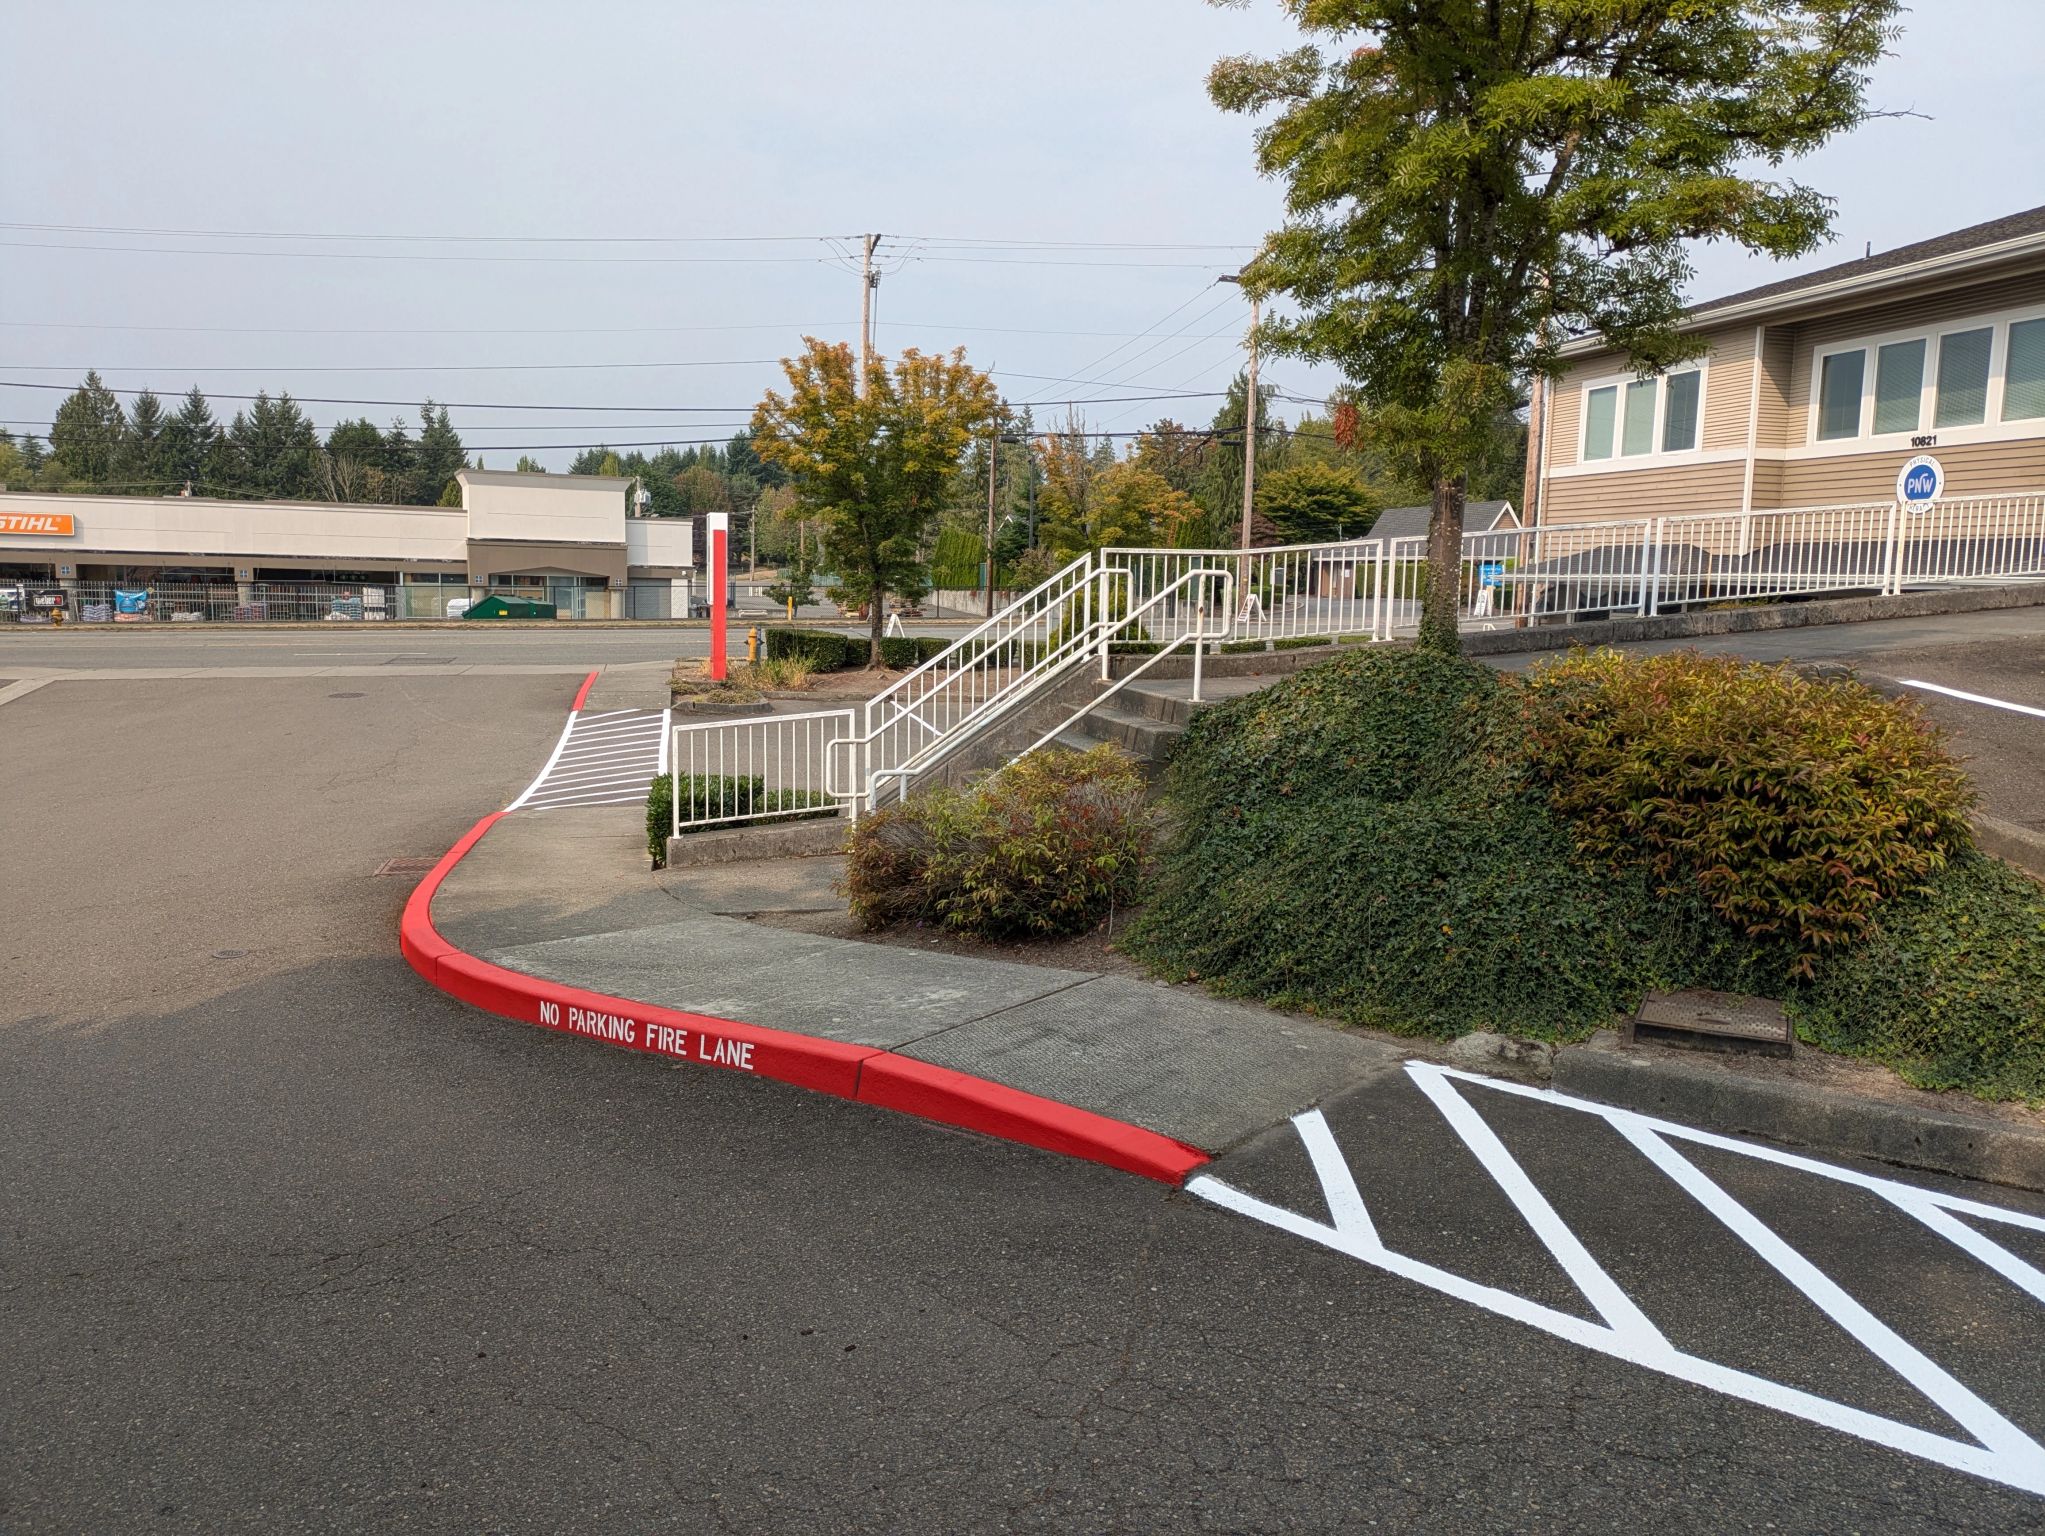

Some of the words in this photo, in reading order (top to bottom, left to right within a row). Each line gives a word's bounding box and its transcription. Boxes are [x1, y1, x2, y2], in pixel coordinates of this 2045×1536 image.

[1911, 435, 1937, 447] 10821
[1909, 457, 1935, 467] PHYSICAL
[1907, 474, 1934, 494] PNW
[540, 1000, 559, 1026] NO
[569, 1007, 635, 1043] PARKING
[646, 1023, 687, 1056] FIRE
[700, 1034, 755, 1070] LANE
